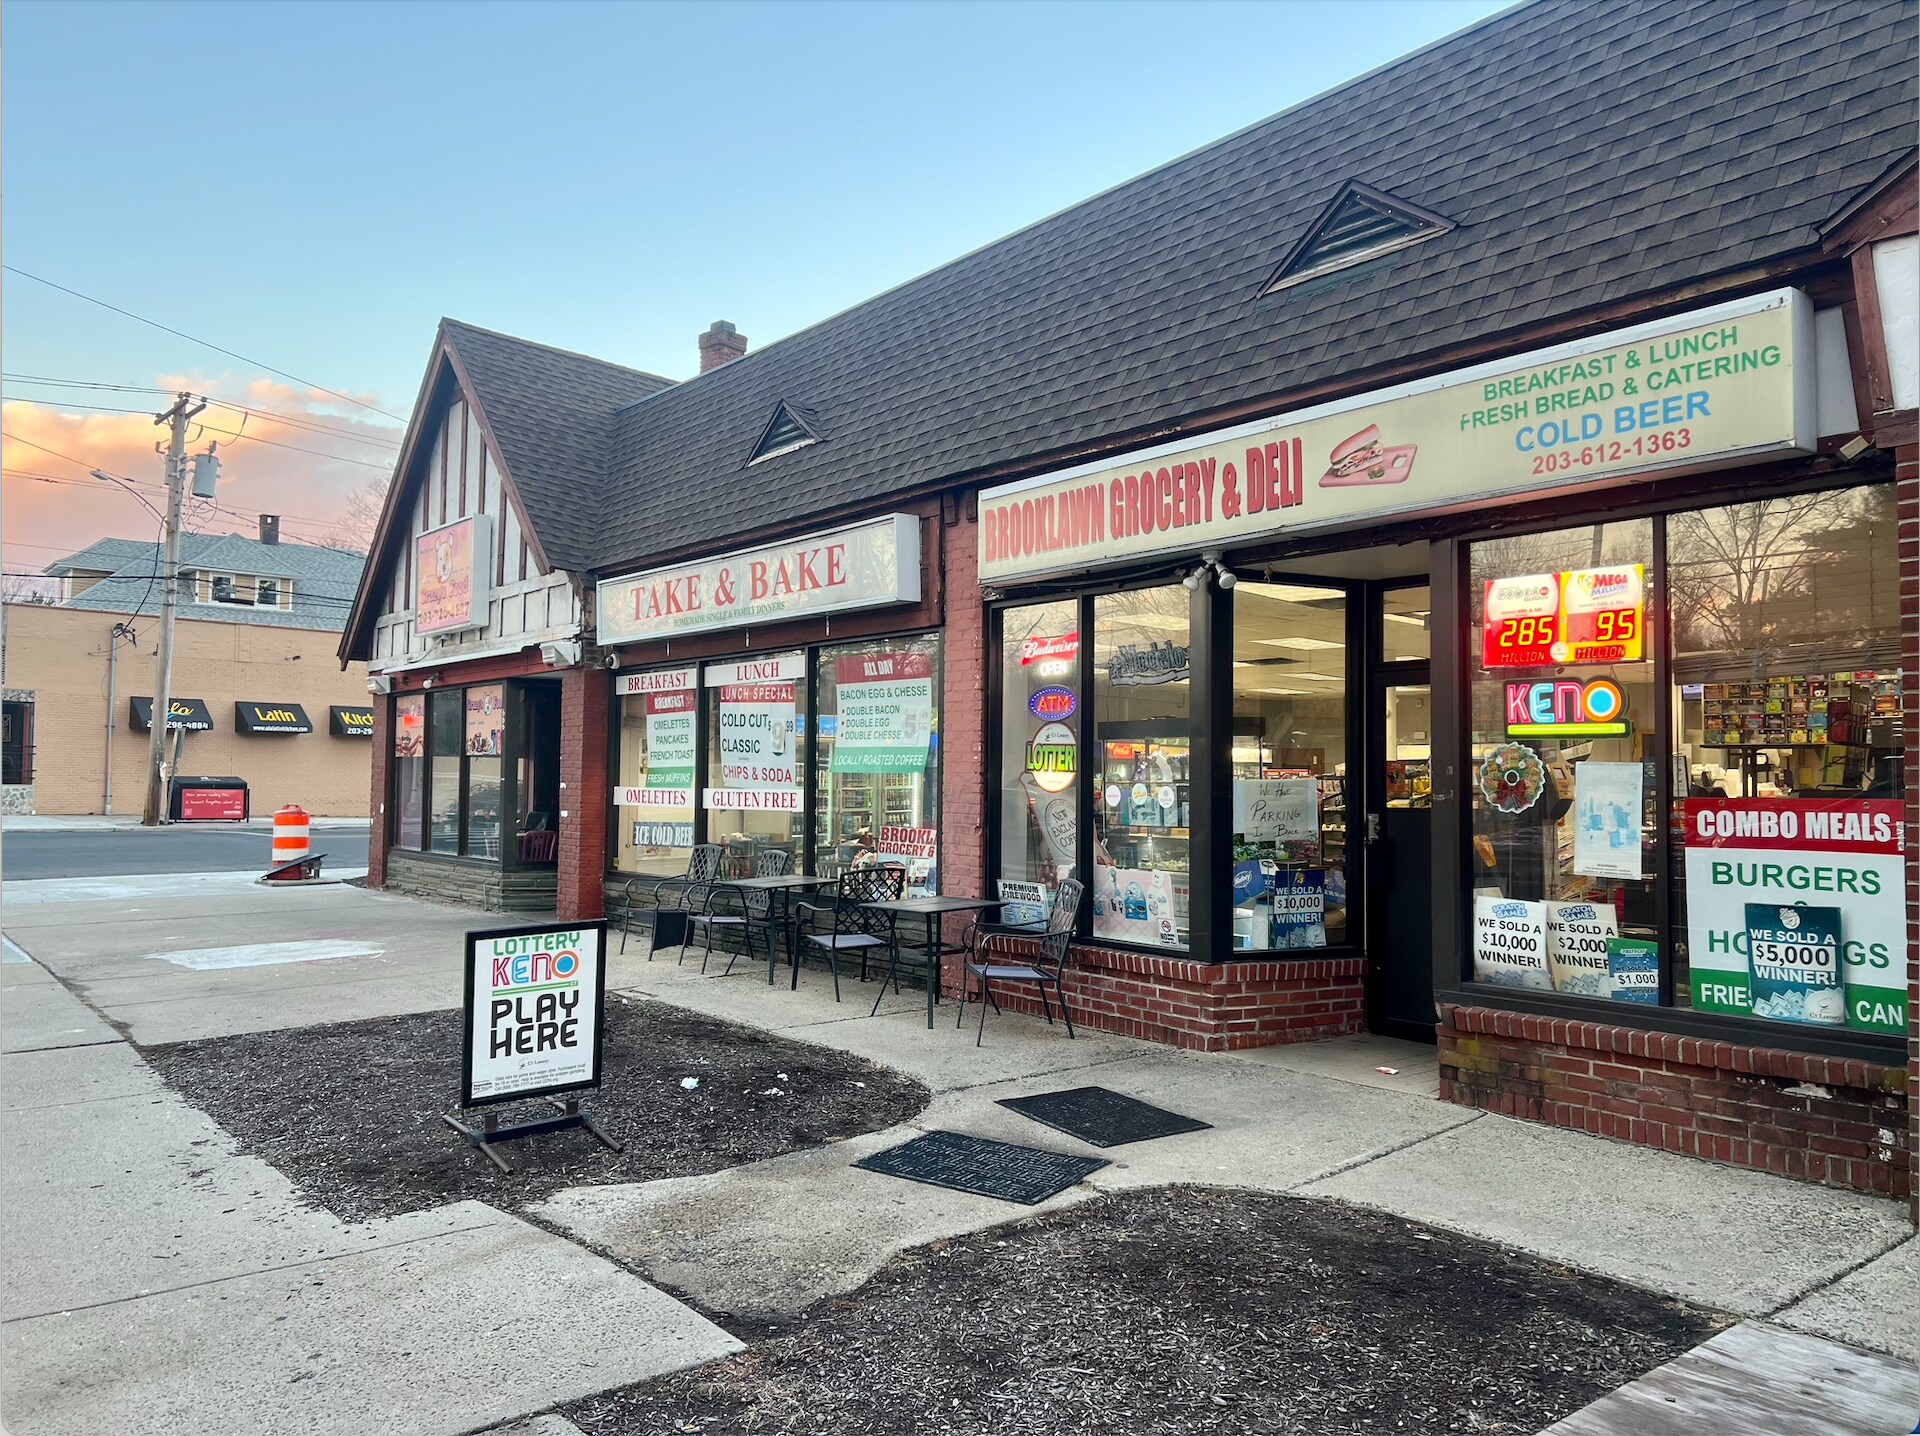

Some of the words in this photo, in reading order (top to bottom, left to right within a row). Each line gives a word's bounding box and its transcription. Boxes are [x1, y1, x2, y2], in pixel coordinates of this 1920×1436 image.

[1484, 354, 1617, 401] BREAKFAST
[1625, 351, 1642, 369] &
[1649, 326, 1739, 365] LUNCH
[1460, 396, 1528, 431] FRESH
[1536, 381, 1615, 422] BREAD
[1623, 378, 1638, 395] &
[1647, 345, 1781, 391] CATERING
[1515, 413, 1603, 453] COLD
[1614, 391, 1711, 434] BEER
[1532, 429, 1692, 475] 203-612-1363
[985, 483, 1105, 563] BROOKLAWN
[1109, 457, 1216, 540] GROCERY
[1221, 462, 1241, 520] &
[1245, 437, 1303, 514] DELI
[631, 574, 702, 621] TAKE
[714, 567, 736, 607] &
[749, 543, 847, 600] BAKE
[1594, 574, 1628, 588] MEGA
[674, 615, 705, 627] HOMEMADE
[706, 611, 728, 622] SINGLE
[733, 606, 757, 618] FAMILY
[757, 601, 786, 615] DINNERS
[1500, 617, 1554, 647] 285
[1597, 610, 1634, 640] 95
[1023, 640, 1078, 658] Budweiser
[1501, 651, 1545, 663] MILLION
[1577, 646, 1626, 659] MILLION
[737, 661, 780, 681] LUNCH
[863, 661, 878, 676] ALL
[878, 659, 894, 675] DAY
[1040, 661, 1068, 676] OPEN
[628, 672, 689, 691] BREAKFAST
[720, 687, 749, 700] LUNCH
[753, 687, 793, 700] SPECIAL
[840, 689, 867, 700] BACON
[868, 688, 885, 699] EGG
[886, 687, 893, 697] &
[894, 685, 928, 697] CHESSE
[654, 694, 685, 709] BREAKFAST
[1037, 696, 1070, 711] ATM
[1507, 680, 1622, 723] KENO
[254, 703, 297, 722] Latin
[846, 706, 874, 716] DOUBLE
[875, 705, 900, 715] BACON
[654, 718, 690, 730] OMELETTES
[721, 713, 746, 727] COLD
[748, 713, 768, 728] CUT
[846, 718, 873, 728] DOUBLE
[874, 718, 890, 727] EGG
[656, 734, 689, 745] PANCAKES
[845, 731, 872, 740] DOUBLE
[873, 730, 902, 740] CHESSE
[650, 751, 674, 760] FRENCH
[674, 749, 694, 760] TOAST
[722, 738, 760, 754] CLASSIC
[834, 755, 863, 765] LOCALLY
[863, 755, 894, 765] ROASTED
[895, 755, 923, 765] COFFEE
[647, 773, 665, 783] FRESH
[665, 773, 691, 782] MUFFINS
[723, 764, 749, 780] CHIPS
[752, 767, 758, 781] &
[761, 767, 792, 783] SODA
[626, 788, 686, 806] OMELETTES
[712, 791, 761, 808] GLUTEN
[763, 792, 797, 809] FREE
[1697, 810, 1798, 839] COMBO
[1805, 812, 1892, 842] MEALS
[635, 825, 650, 845] ICE
[651, 825, 674, 846] COLD
[674, 826, 693, 847] BEER
[880, 826, 937, 845] BROOKL
[879, 842, 926, 857] GROCERY
[927, 846, 935, 858] &
[1712, 861, 1881, 895] BURGERS
[1002, 882, 1039, 893] PREMIUM
[1276, 887, 1289, 895] WE
[1291, 886, 1314, 895] SOLD
[1316, 886, 1322, 894] A
[1001, 891, 1041, 902] FIREWOOD
[1277, 897, 1320, 911] $10,000
[1492, 902, 1525, 912] SCRATCH
[1496, 909, 1528, 919] GAMES
[1558, 905, 1592, 916] SCRATCH
[1276, 912, 1321, 924] WINNER!
[1479, 917, 1496, 928] WE
[1499, 920, 1530, 932] SOLD
[1533, 925, 1542, 934] A
[1563, 912, 1596, 922] GAMES
[1547, 921, 1565, 932] WE
[1569, 924, 1601, 935] SOLD
[1606, 927, 1615, 936] A
[1750, 928, 1772, 940] WE
[1776, 930, 1819, 944] SOLD
[1824, 934, 1836, 945] A
[493, 931, 581, 956] LOTTERY
[1483, 932, 1537, 951] $10,000
[1559, 937, 1607, 954] $2,000
[1708, 930, 1747, 955] HO
[1843, 940, 1890, 969] GS
[1479, 949, 1542, 968] WINNER!
[1756, 944, 1830, 967] $5,000
[492, 950, 580, 987] KENO
[1754, 966, 1836, 986] WINNER!
[1618, 974, 1656, 985] $1,000
[491, 989, 579, 1029] PLAY
[1701, 983, 1752, 1008] FRIE
[1856, 1000, 1903, 1026] CAN
[489, 1018, 579, 1059] HERE
